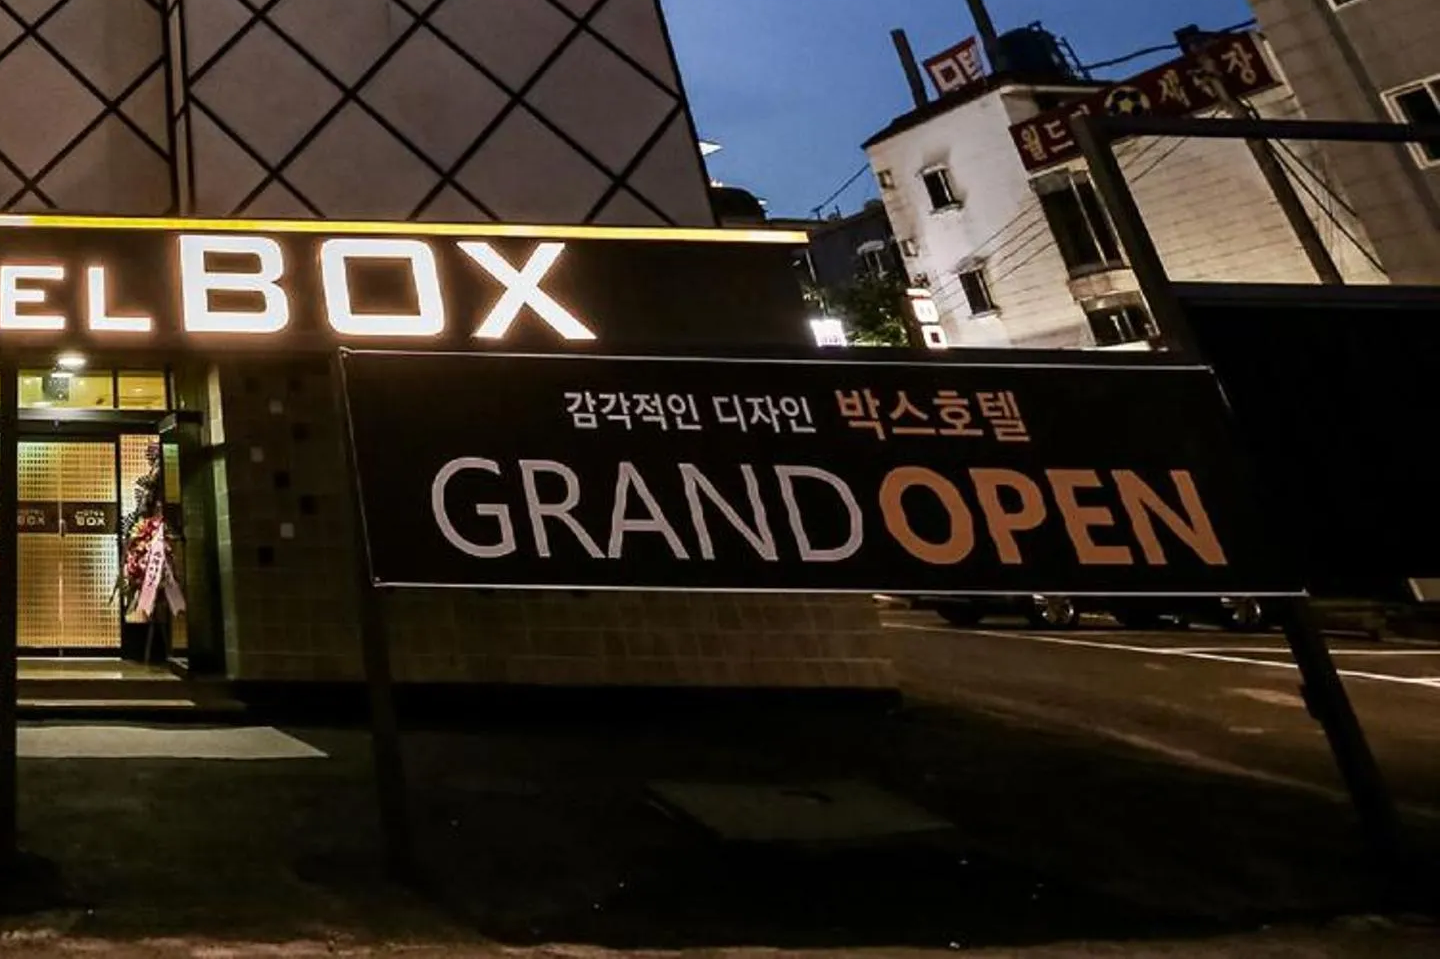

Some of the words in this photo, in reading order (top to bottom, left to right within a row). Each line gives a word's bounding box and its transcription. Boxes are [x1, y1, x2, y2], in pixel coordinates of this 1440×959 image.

[178, 235, 597, 339] BOX
[564, 391, 702, 431] 감각적인
[712, 394, 817, 433] 디자인
[834, 389, 1030, 441] 박스호텔
[431, 457, 863, 561] GRAND
[879, 466, 1228, 565] OPEN
